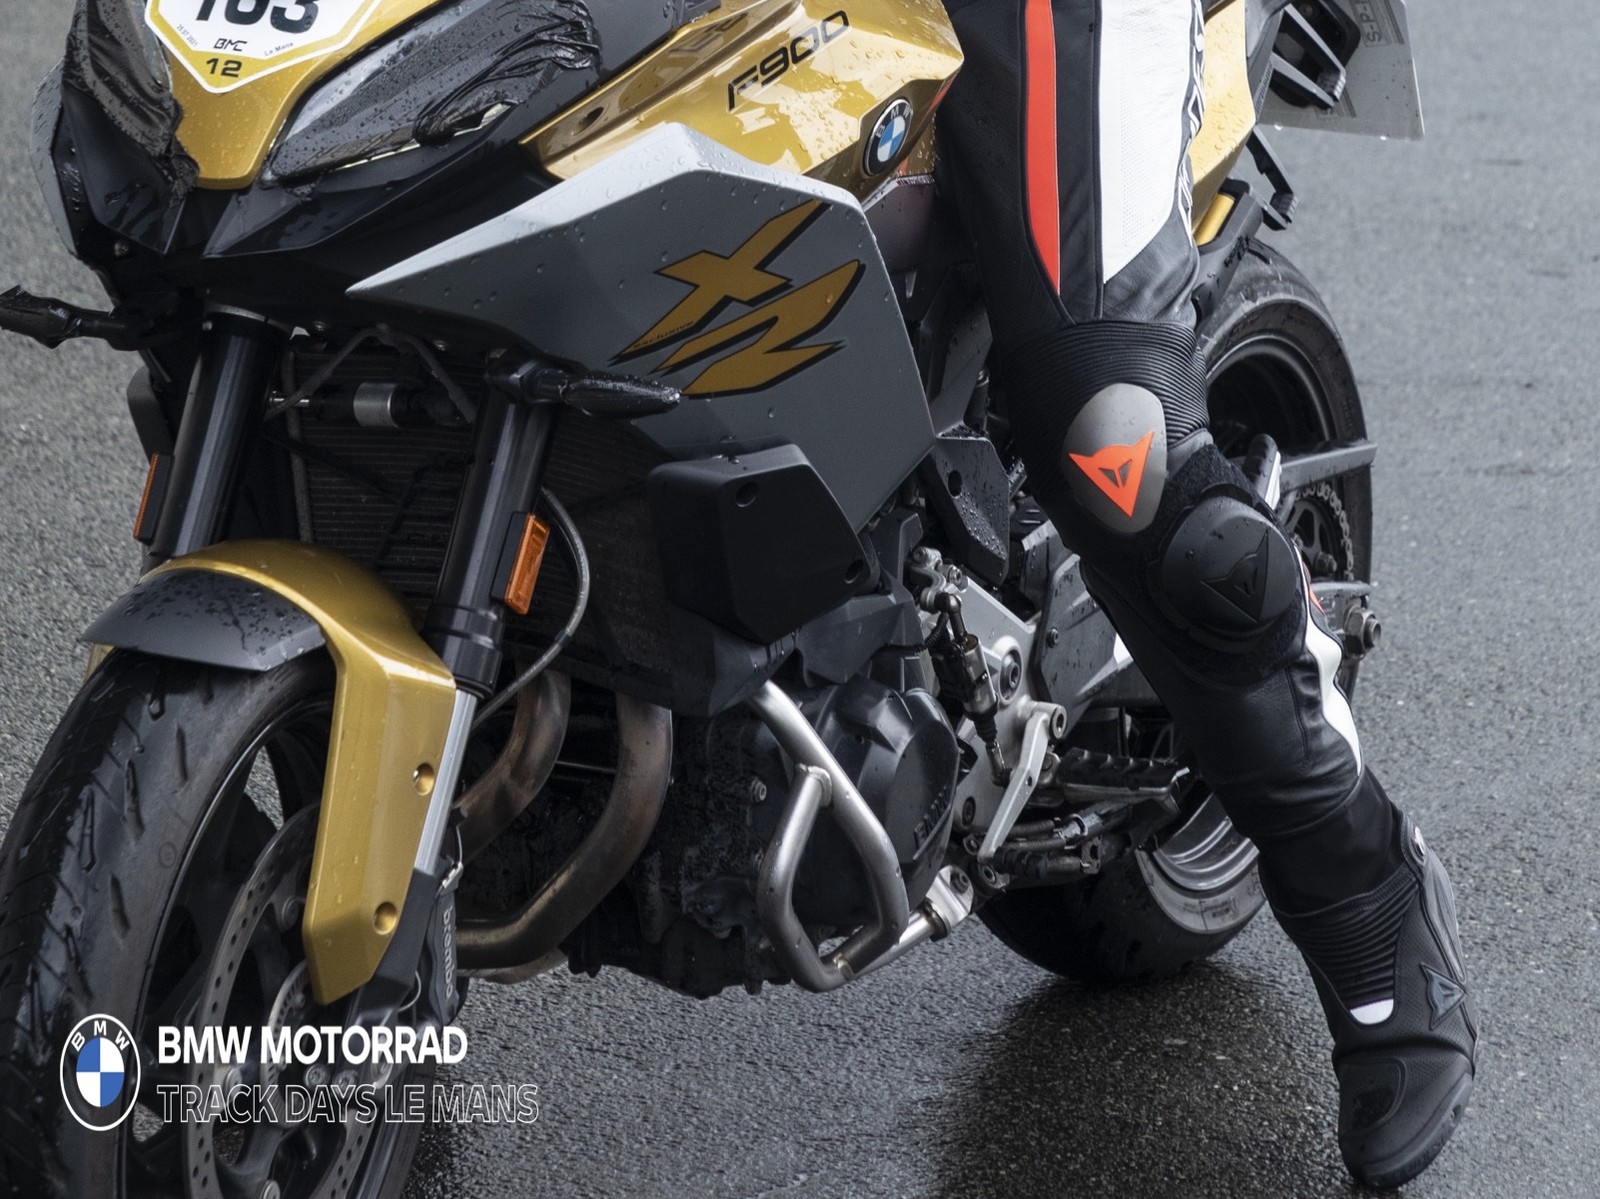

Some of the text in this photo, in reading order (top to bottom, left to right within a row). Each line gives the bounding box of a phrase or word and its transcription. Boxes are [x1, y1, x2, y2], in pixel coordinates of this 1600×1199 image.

[206, 58, 242, 78] 12
[728, 10, 849, 111] F900
[876, 104, 914, 138] BMW
[443, 905, 455, 999] brembo
